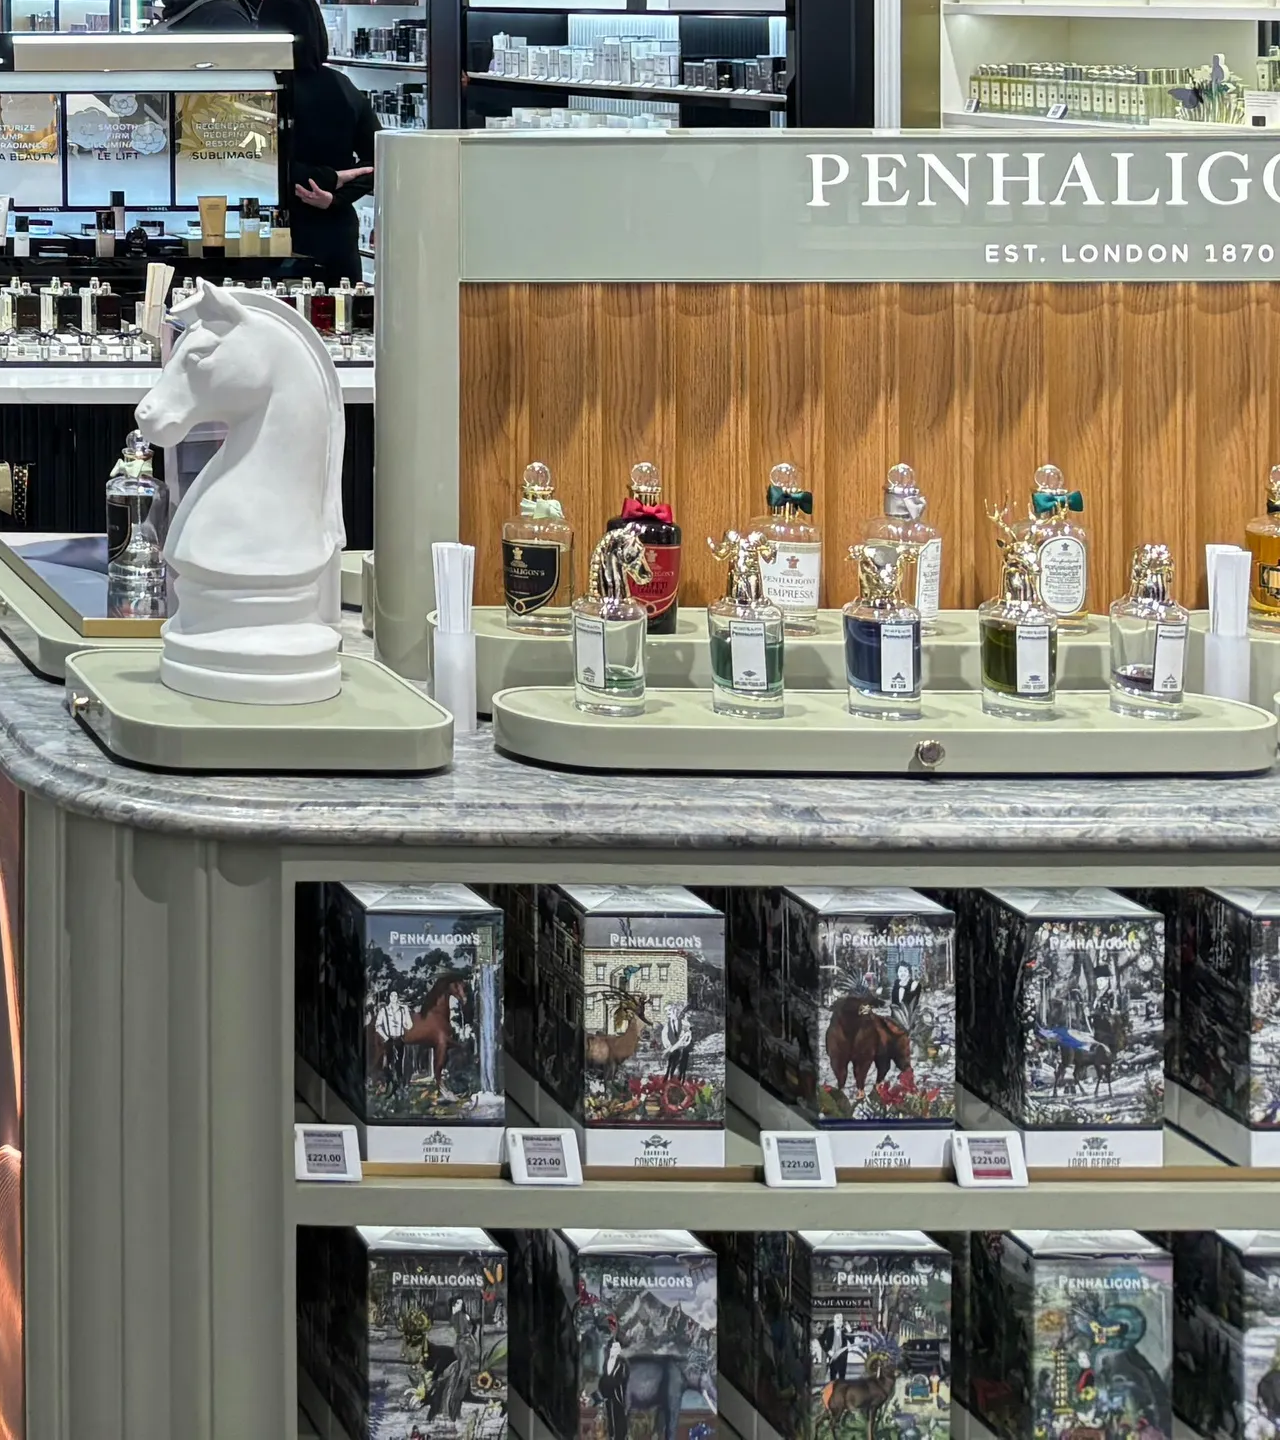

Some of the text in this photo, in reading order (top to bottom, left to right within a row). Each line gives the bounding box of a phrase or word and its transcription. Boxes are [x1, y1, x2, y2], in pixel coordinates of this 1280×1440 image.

[196, 122, 256, 130] REGENERATE
[9, 153, 56, 161] BEAUTY
[97, 152, 139, 160] LE LIFT
[192, 151, 262, 160] SUBLIMAGE
[985, 243, 1276, 263] EST. LONDON 1870
[767, 587, 814, 599] EMPRESSA
[389, 930, 480, 947] PENHALIGON'S
[609, 932, 702, 949] PENHALIGON'S
[307, 1153, 342, 1163] £221.00
[527, 1157, 561, 1167] £221.00
[972, 1156, 1007, 1166] £221.00
[781, 1160, 816, 1170] £221.00
[392, 1270, 484, 1288] PENHALIGON'S
[602, 1272, 694, 1289] PENHALIGON'S
[836, 1271, 929, 1287] PENHALIGON'S
[1058, 1274, 1150, 1290] PENHALIGON'S
